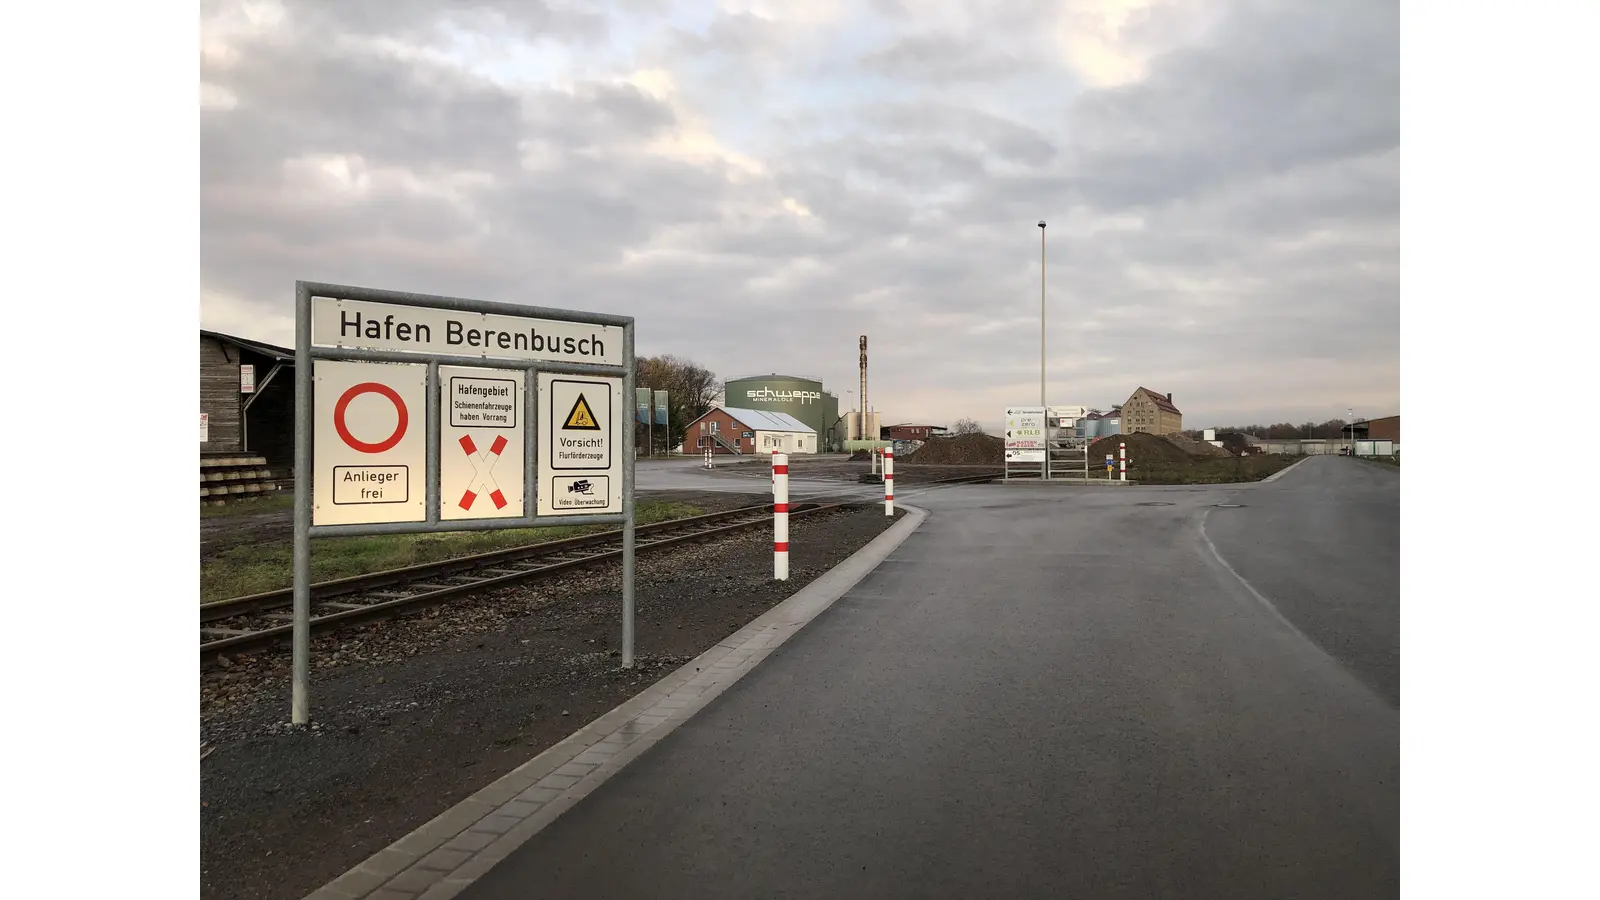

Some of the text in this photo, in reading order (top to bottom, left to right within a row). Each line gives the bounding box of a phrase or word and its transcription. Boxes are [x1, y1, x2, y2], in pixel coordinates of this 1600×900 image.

[340, 311, 605, 356] Hafen Berenbusch
[458, 384, 508, 398] Hafengebiet
[747, 386, 820, 404] schweppe
[454, 400, 512, 412] Schienenfahrzeuge
[459, 412, 507, 423] haben Vorrang
[559, 437, 603, 448] Vorsicht!
[558, 451, 604, 461] Flurförderzeuge
[343, 470, 400, 484] Anlieger
[361, 487, 383, 499] frei
